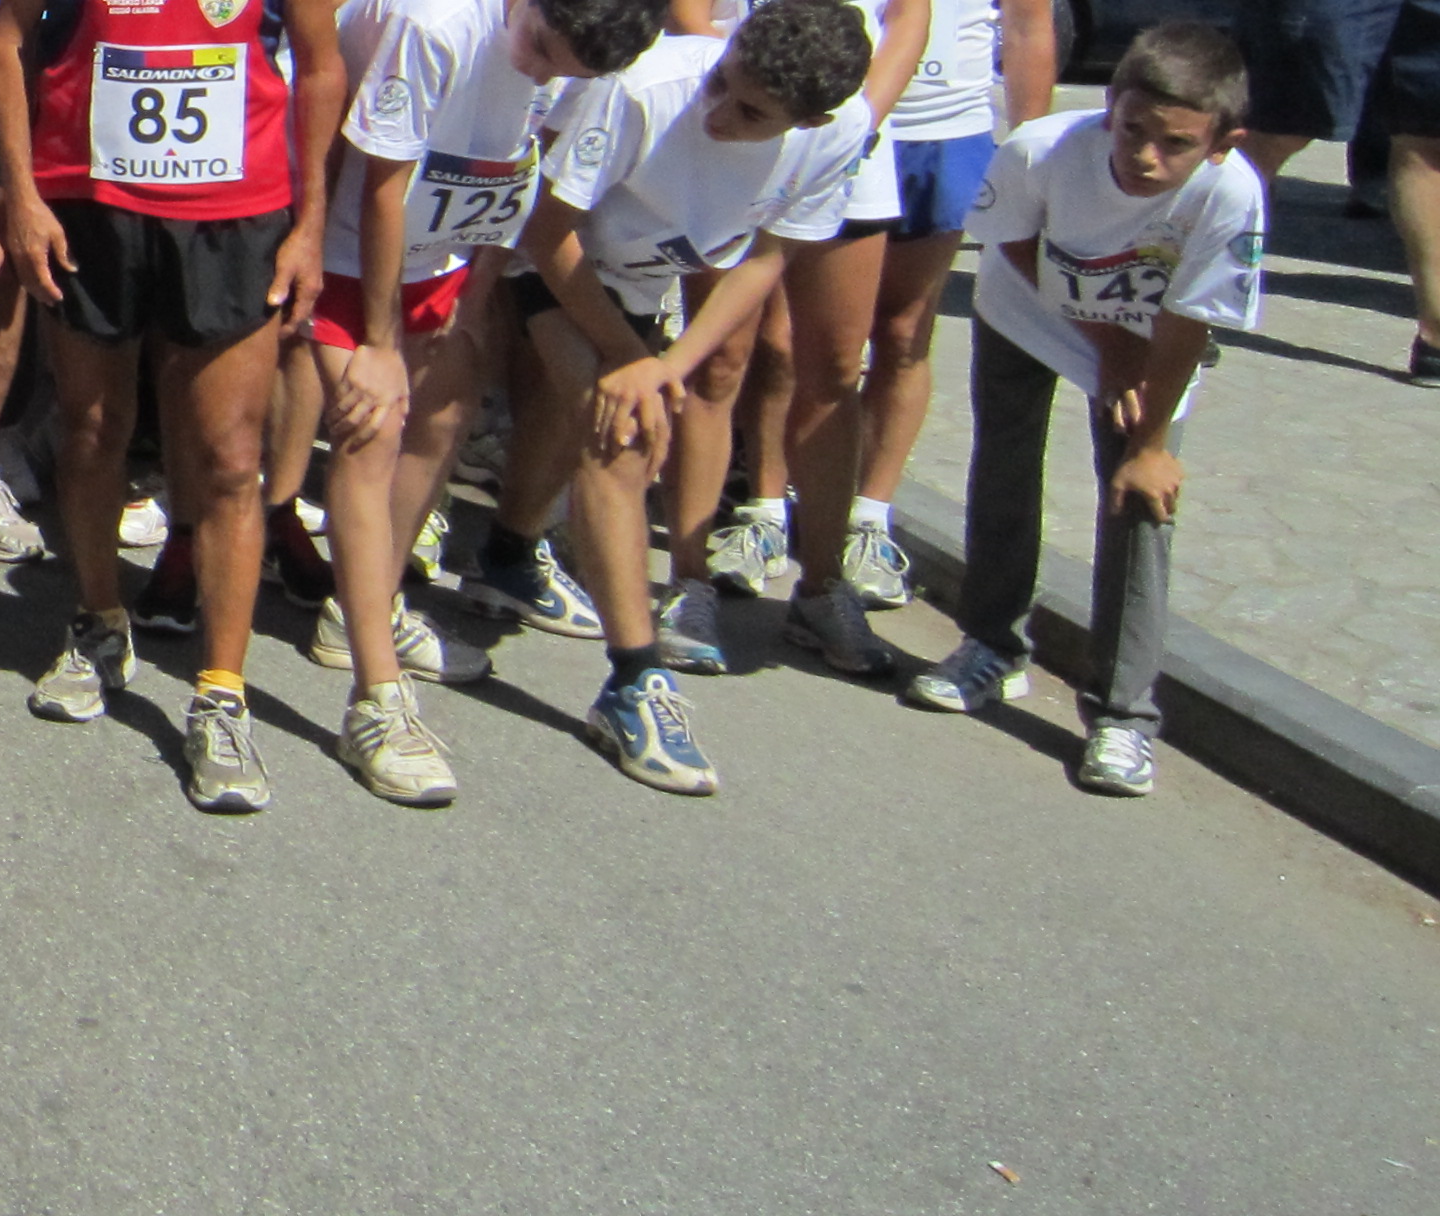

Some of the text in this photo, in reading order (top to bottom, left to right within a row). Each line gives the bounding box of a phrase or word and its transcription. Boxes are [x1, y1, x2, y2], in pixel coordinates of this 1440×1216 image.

[106, 67, 196, 80] SALOMON
[129, 87, 208, 144] 85
[112, 158, 228, 178] SUUNTO
[428, 184, 529, 233] 125
[1059, 269, 1169, 305] 142
